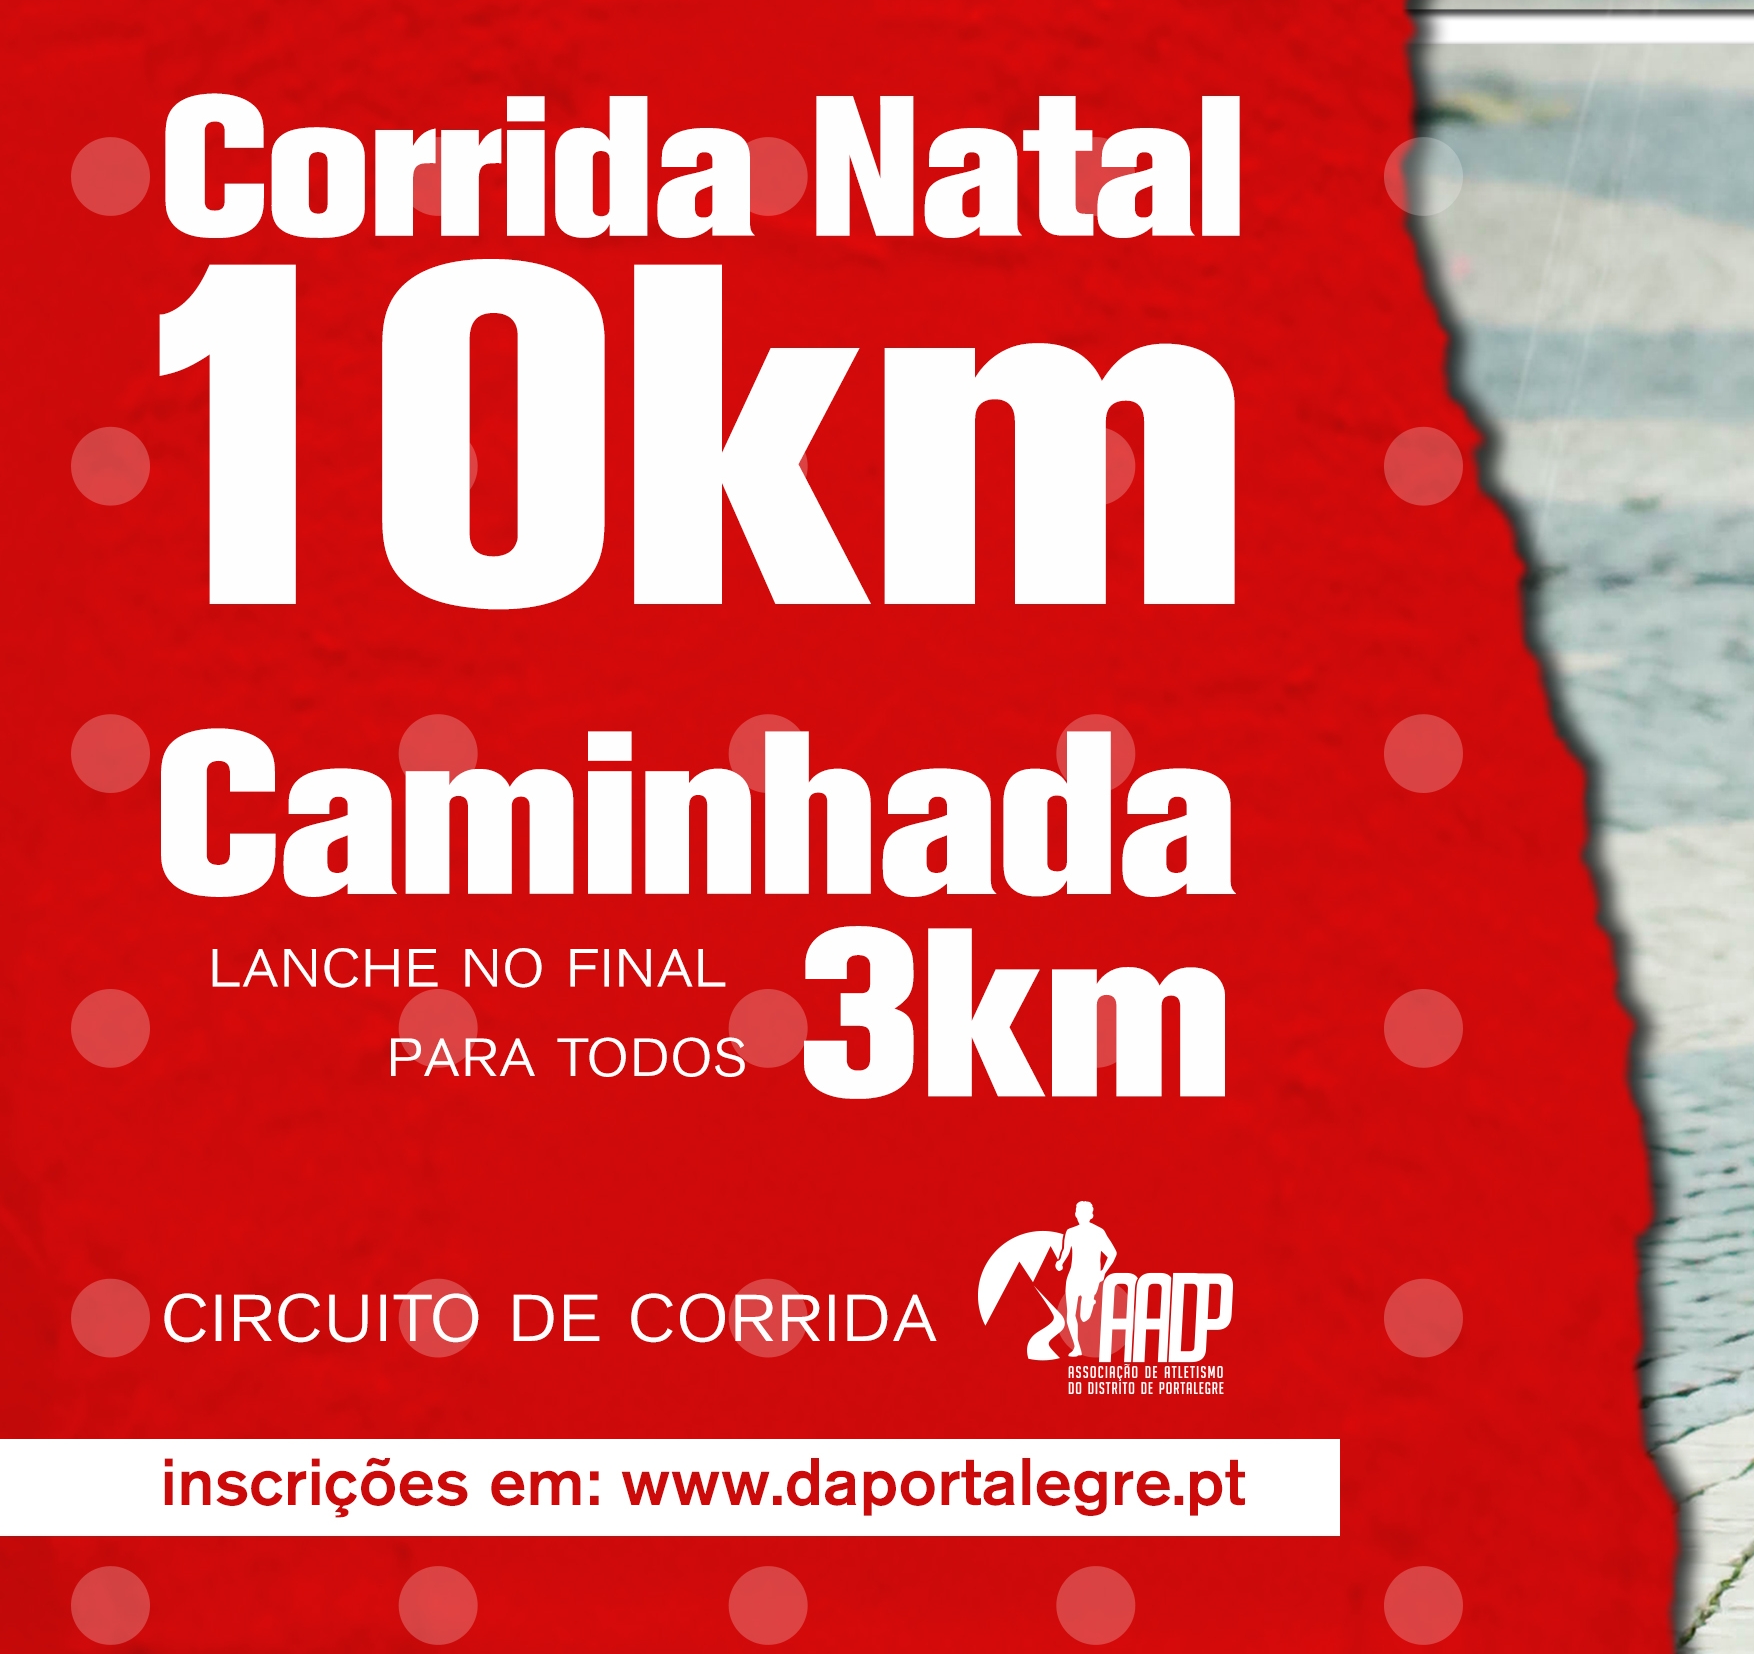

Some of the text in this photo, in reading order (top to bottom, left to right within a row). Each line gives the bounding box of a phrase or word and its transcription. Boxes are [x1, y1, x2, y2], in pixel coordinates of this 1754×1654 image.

[165, 93, 1240, 239] Corrida Natal
[159, 258, 1236, 610] 10km
[160, 728, 1236, 898] Caminhada
[211, 947, 726, 989] LANCHE NO FINAL
[803, 925, 1226, 1100] 3km
[390, 1037, 746, 1078] PARA TODOS
[163, 1293, 937, 1343] CIRCUITO DE CORRIDA
[1098, 1272, 1234, 1363] AADP
[1068, 1364, 1224, 1381] ASSOCIAÇÃO DE ATLETISMO
[1068, 1381, 1225, 1395] DO DISTRITO DE PORTALEGRE
[164, 1457, 1246, 1518] inscrições em: www.daportalegre.pt
